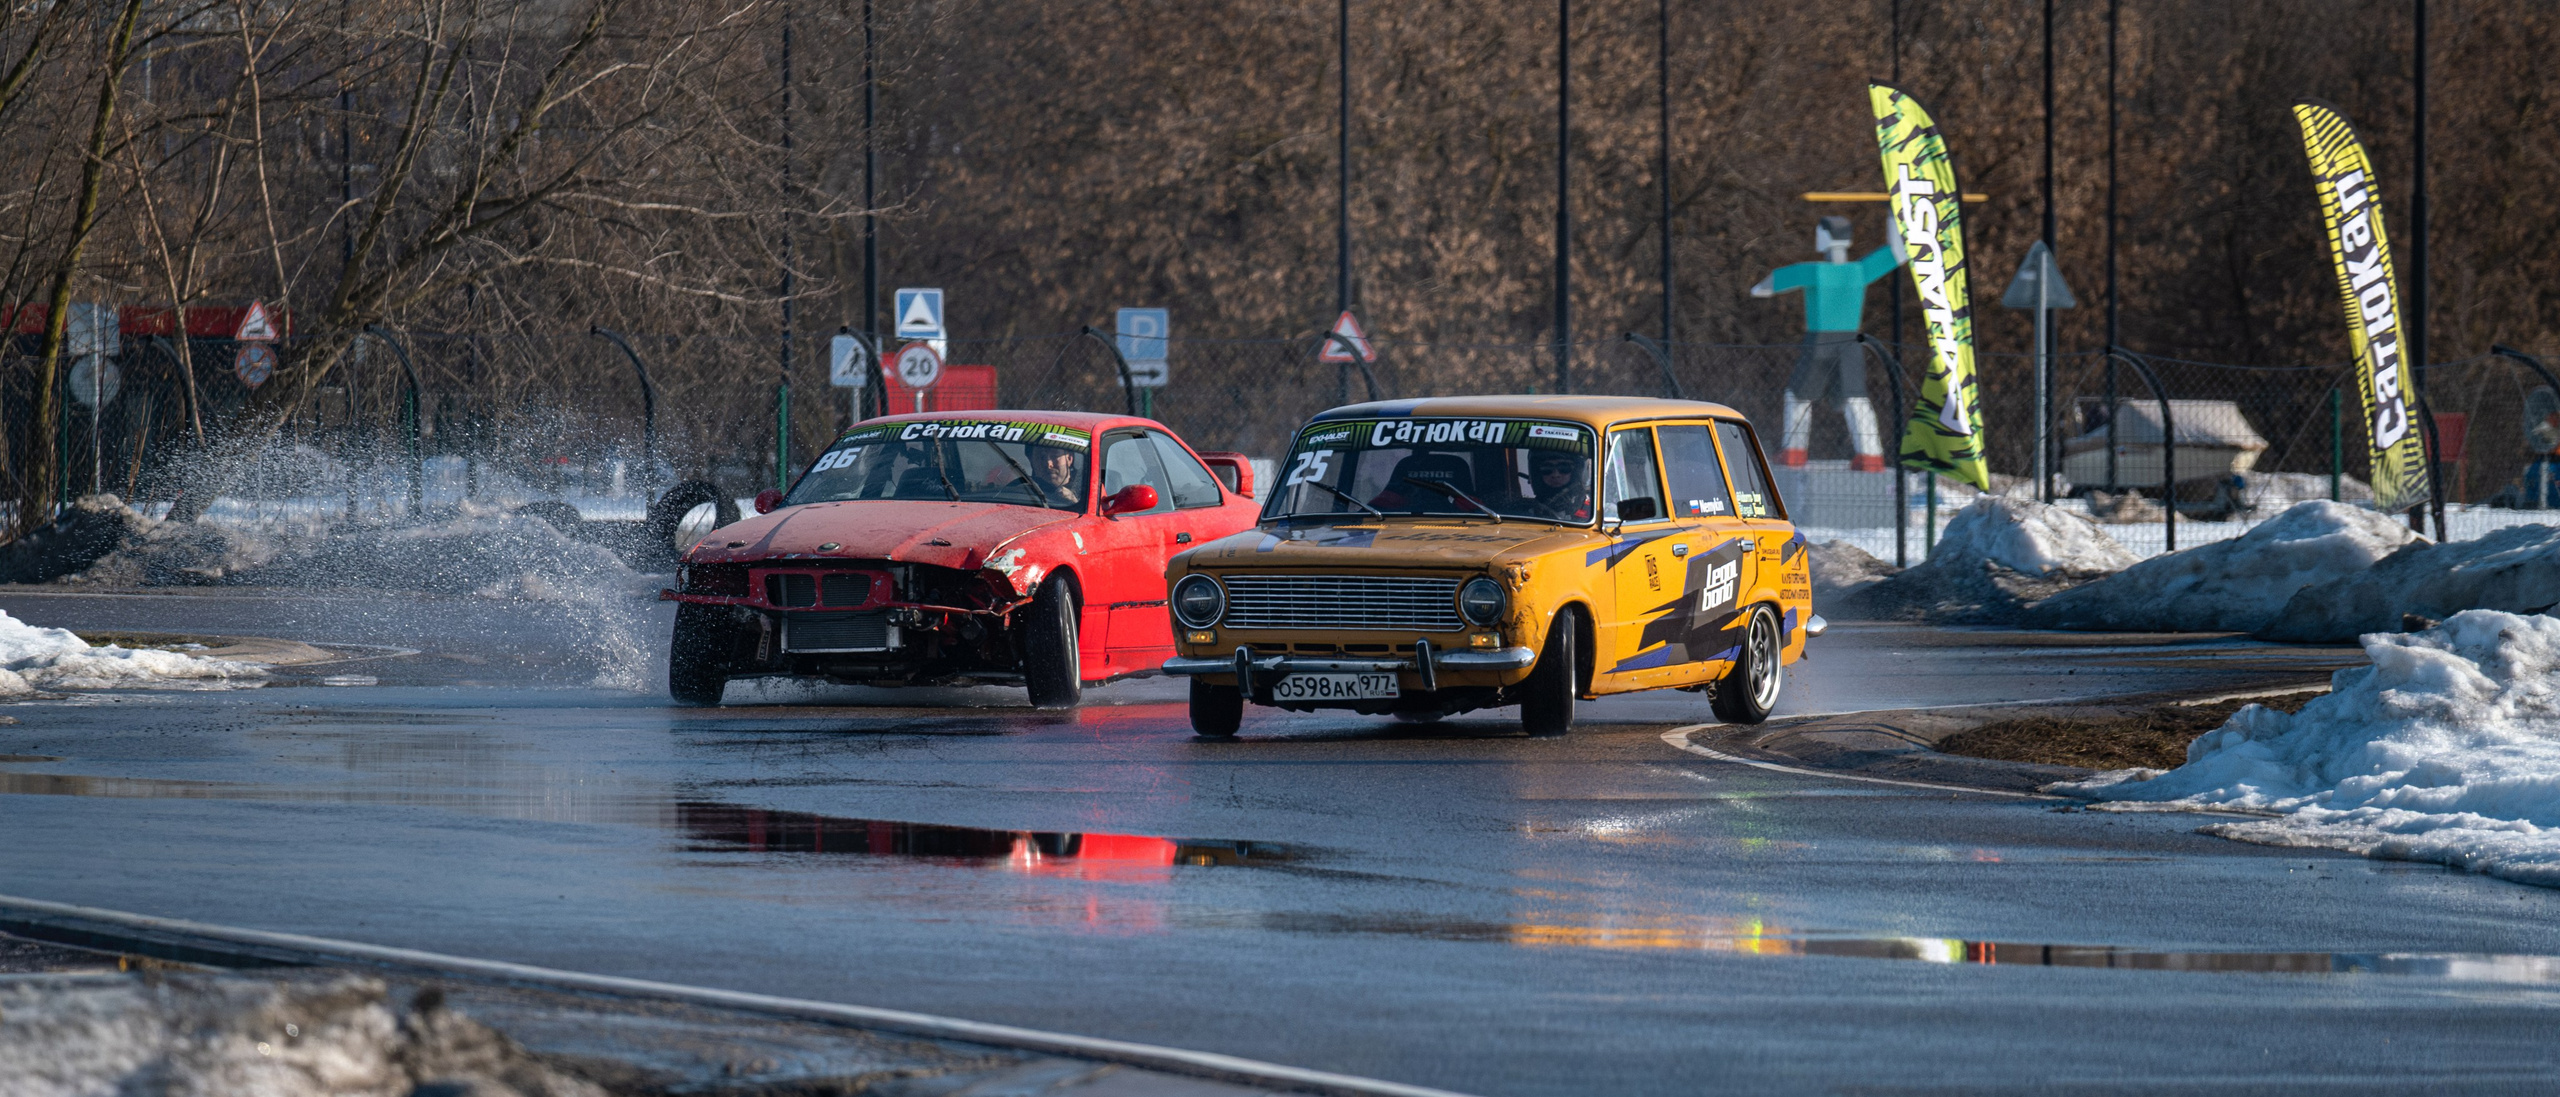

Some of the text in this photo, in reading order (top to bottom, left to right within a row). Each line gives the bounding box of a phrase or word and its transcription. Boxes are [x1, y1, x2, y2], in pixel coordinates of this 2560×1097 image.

[1132, 315, 1158, 355] P
[906, 357, 932, 377] 20
[1308, 431, 1351, 445] EXHAUST
[1286, 450, 1334, 487] 25
[1360, 675, 1390, 690] 977
[1369, 689, 1385, 697] RUS
